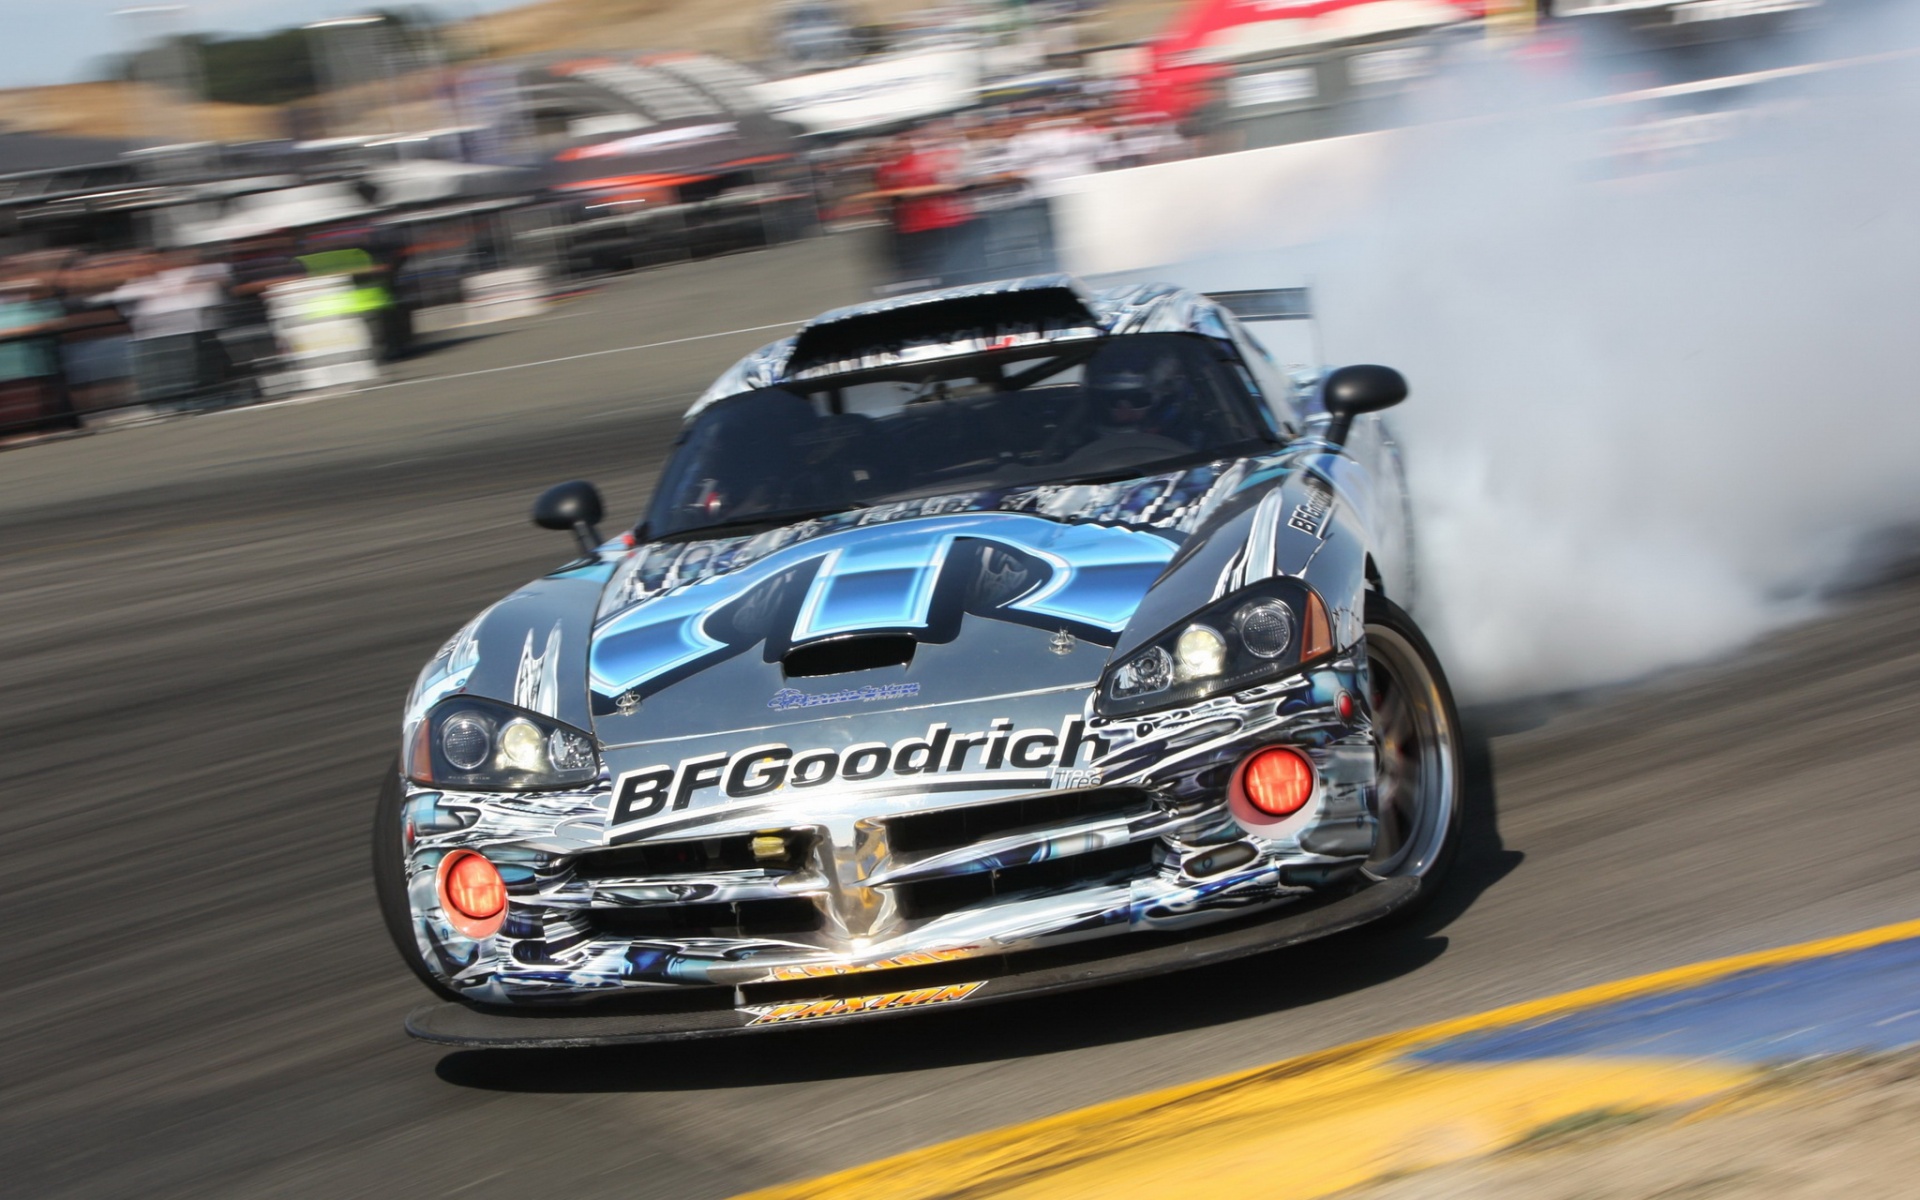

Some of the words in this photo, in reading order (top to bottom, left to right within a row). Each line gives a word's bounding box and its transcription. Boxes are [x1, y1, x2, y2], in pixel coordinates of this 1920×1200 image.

[606, 714, 1111, 826] BFGoodrich
[1049, 765, 1101, 790] Tires
[764, 982, 978, 1020] PAXTON
